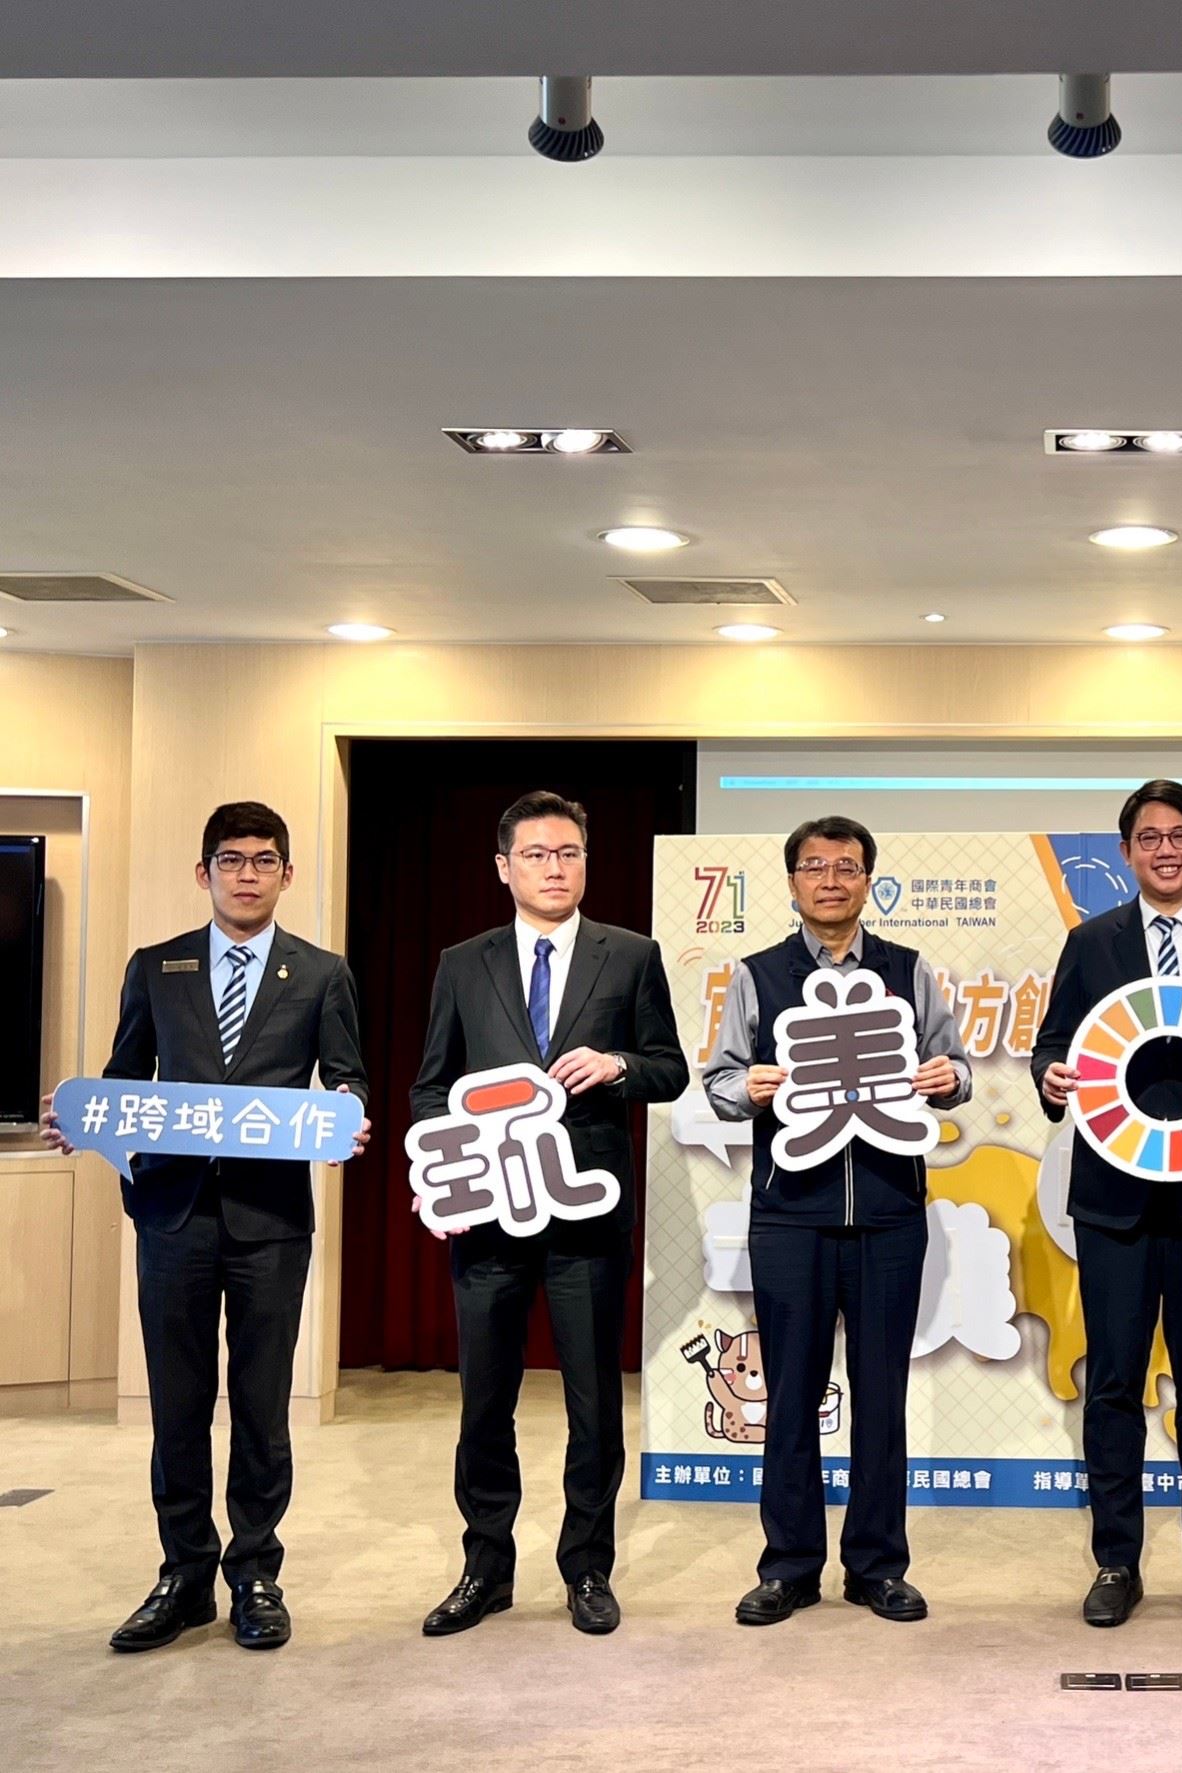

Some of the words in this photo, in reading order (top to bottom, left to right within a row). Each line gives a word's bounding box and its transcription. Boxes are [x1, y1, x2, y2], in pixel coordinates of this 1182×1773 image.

[911, 879, 997, 893] 國際青年商會
[911, 896, 997, 910] 中華民國總會
[696, 921, 745, 933] 2023
[879, 917, 949, 927] International
[956, 917, 996, 927] TAIWAN
[784, 981, 929, 1158] 美
[81, 1094, 337, 1149] #跨域合作
